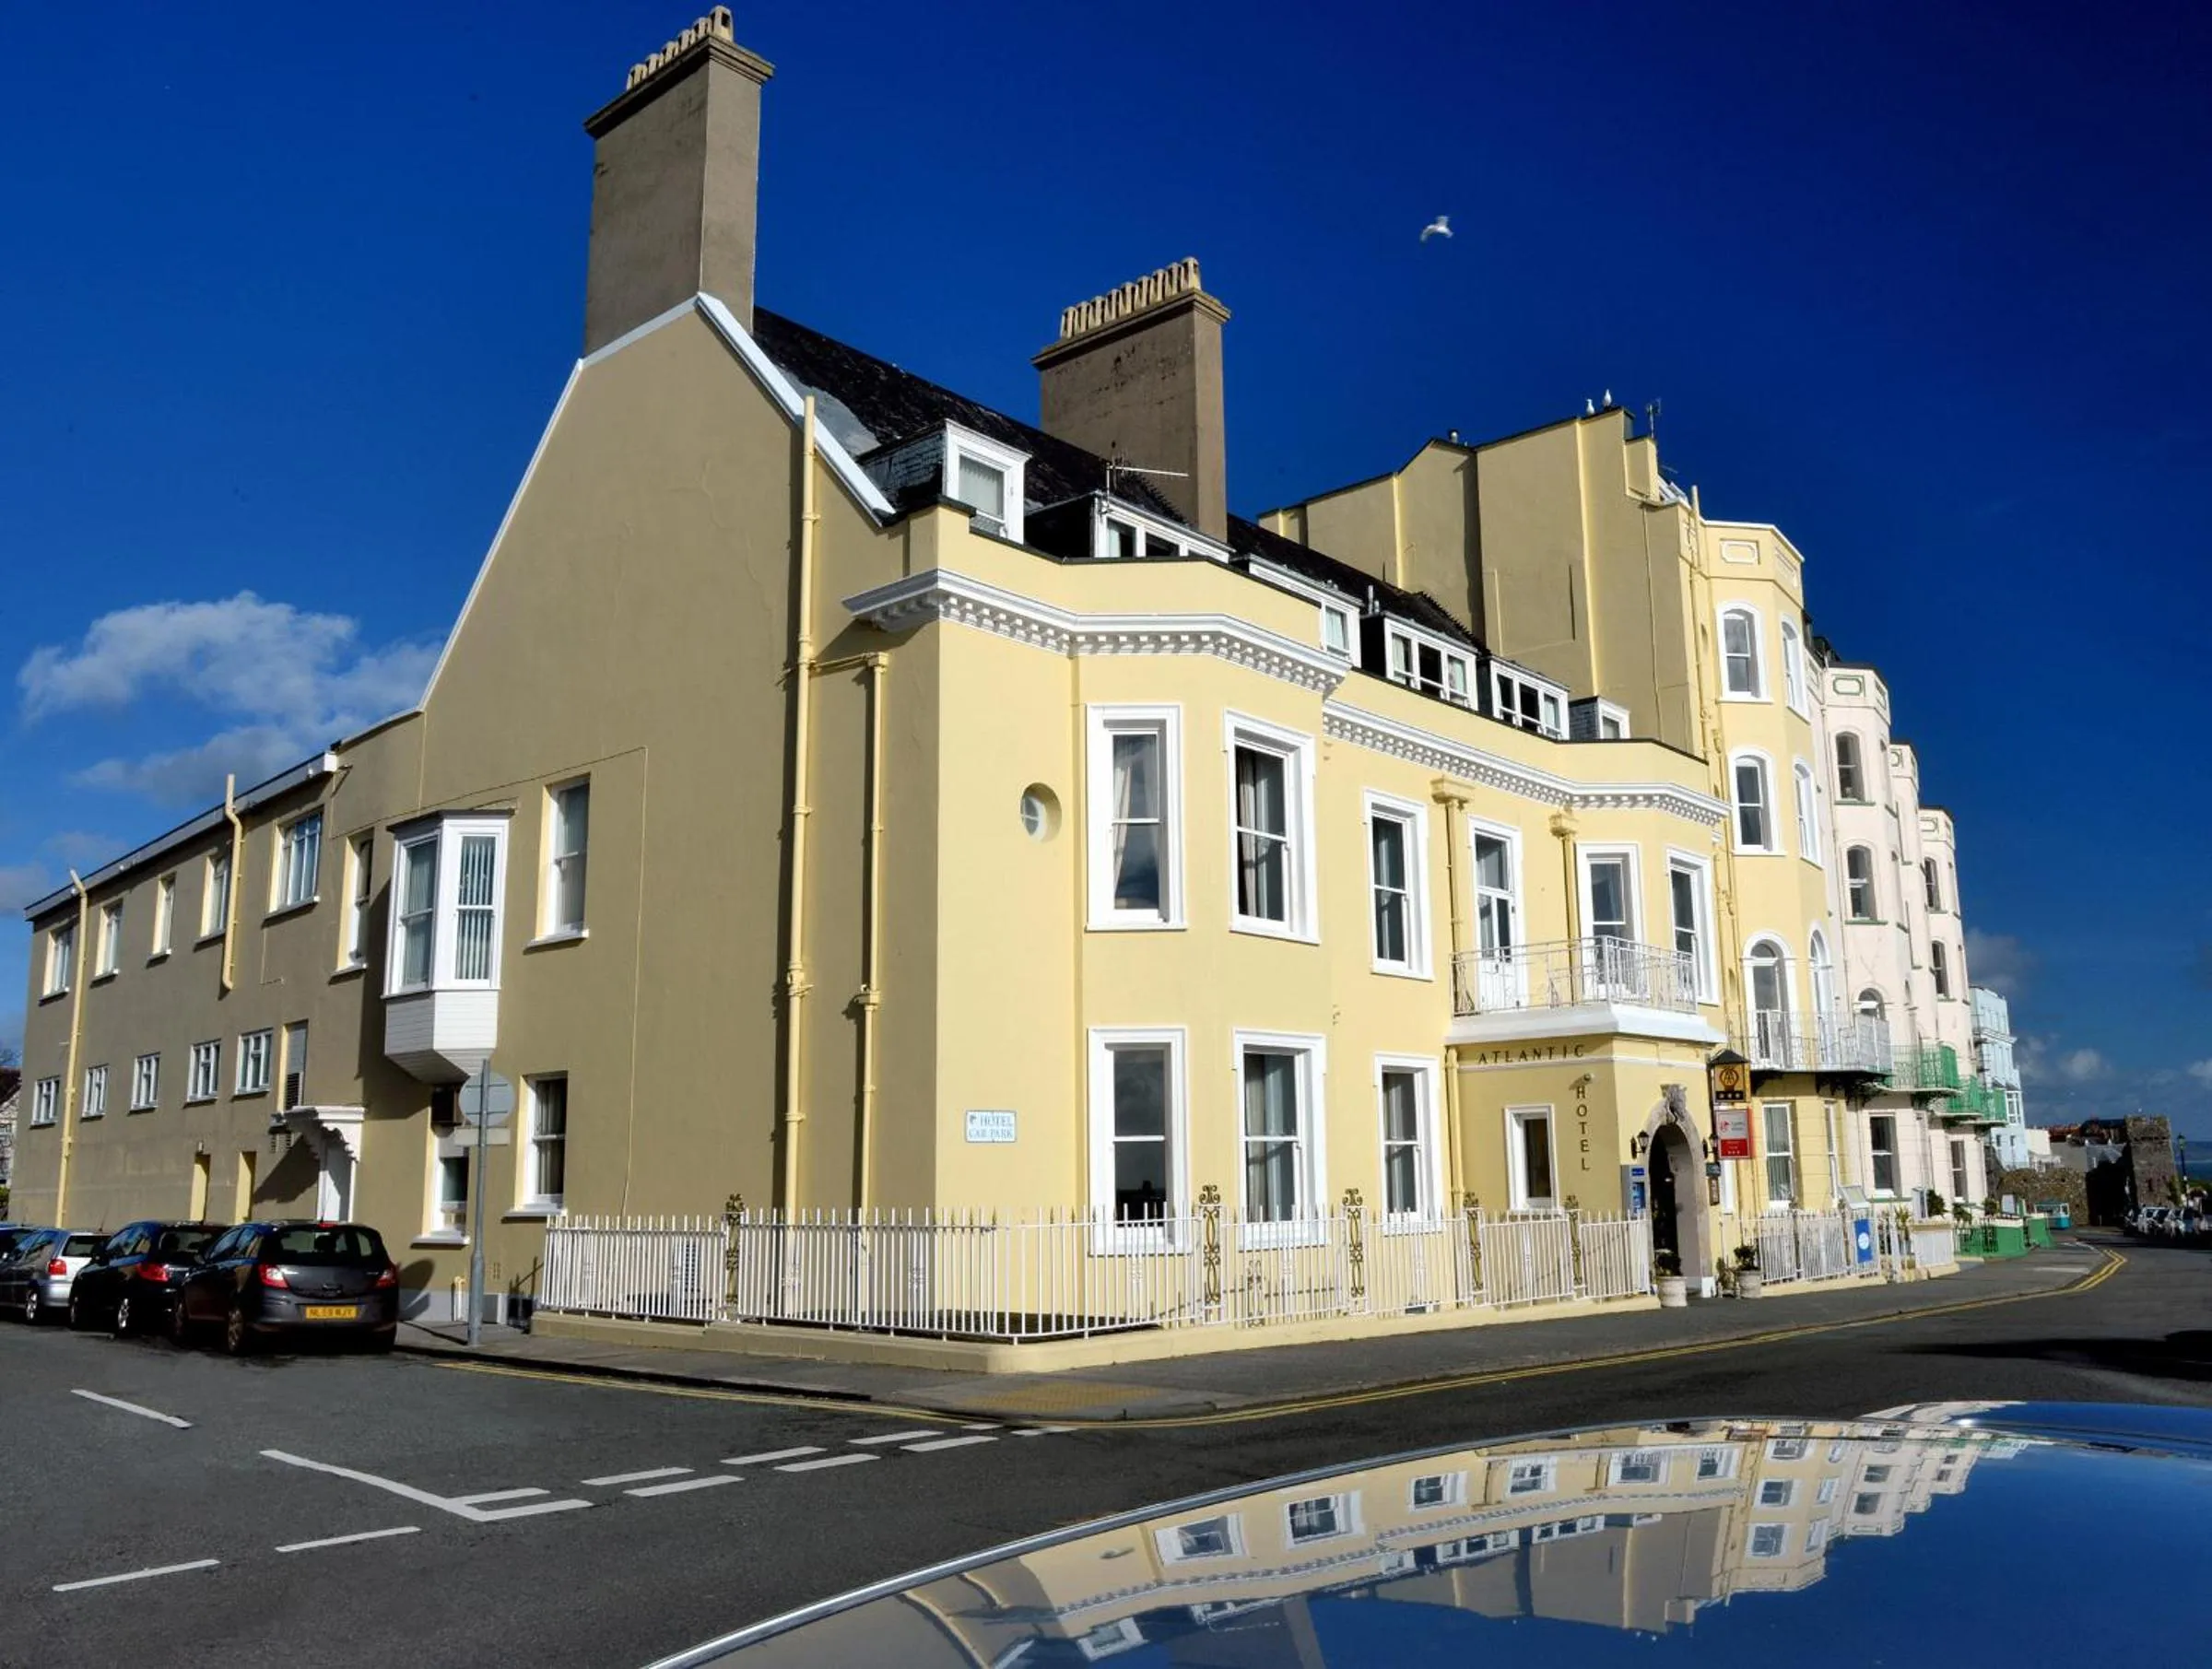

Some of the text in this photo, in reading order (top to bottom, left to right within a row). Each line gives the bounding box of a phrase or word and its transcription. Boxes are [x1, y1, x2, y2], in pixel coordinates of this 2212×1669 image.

[1478, 1044, 1583, 1064] ATLANTIC
[980, 1113, 1012, 1126] HOTEL
[1577, 1086, 1590, 1170] HOTEL
